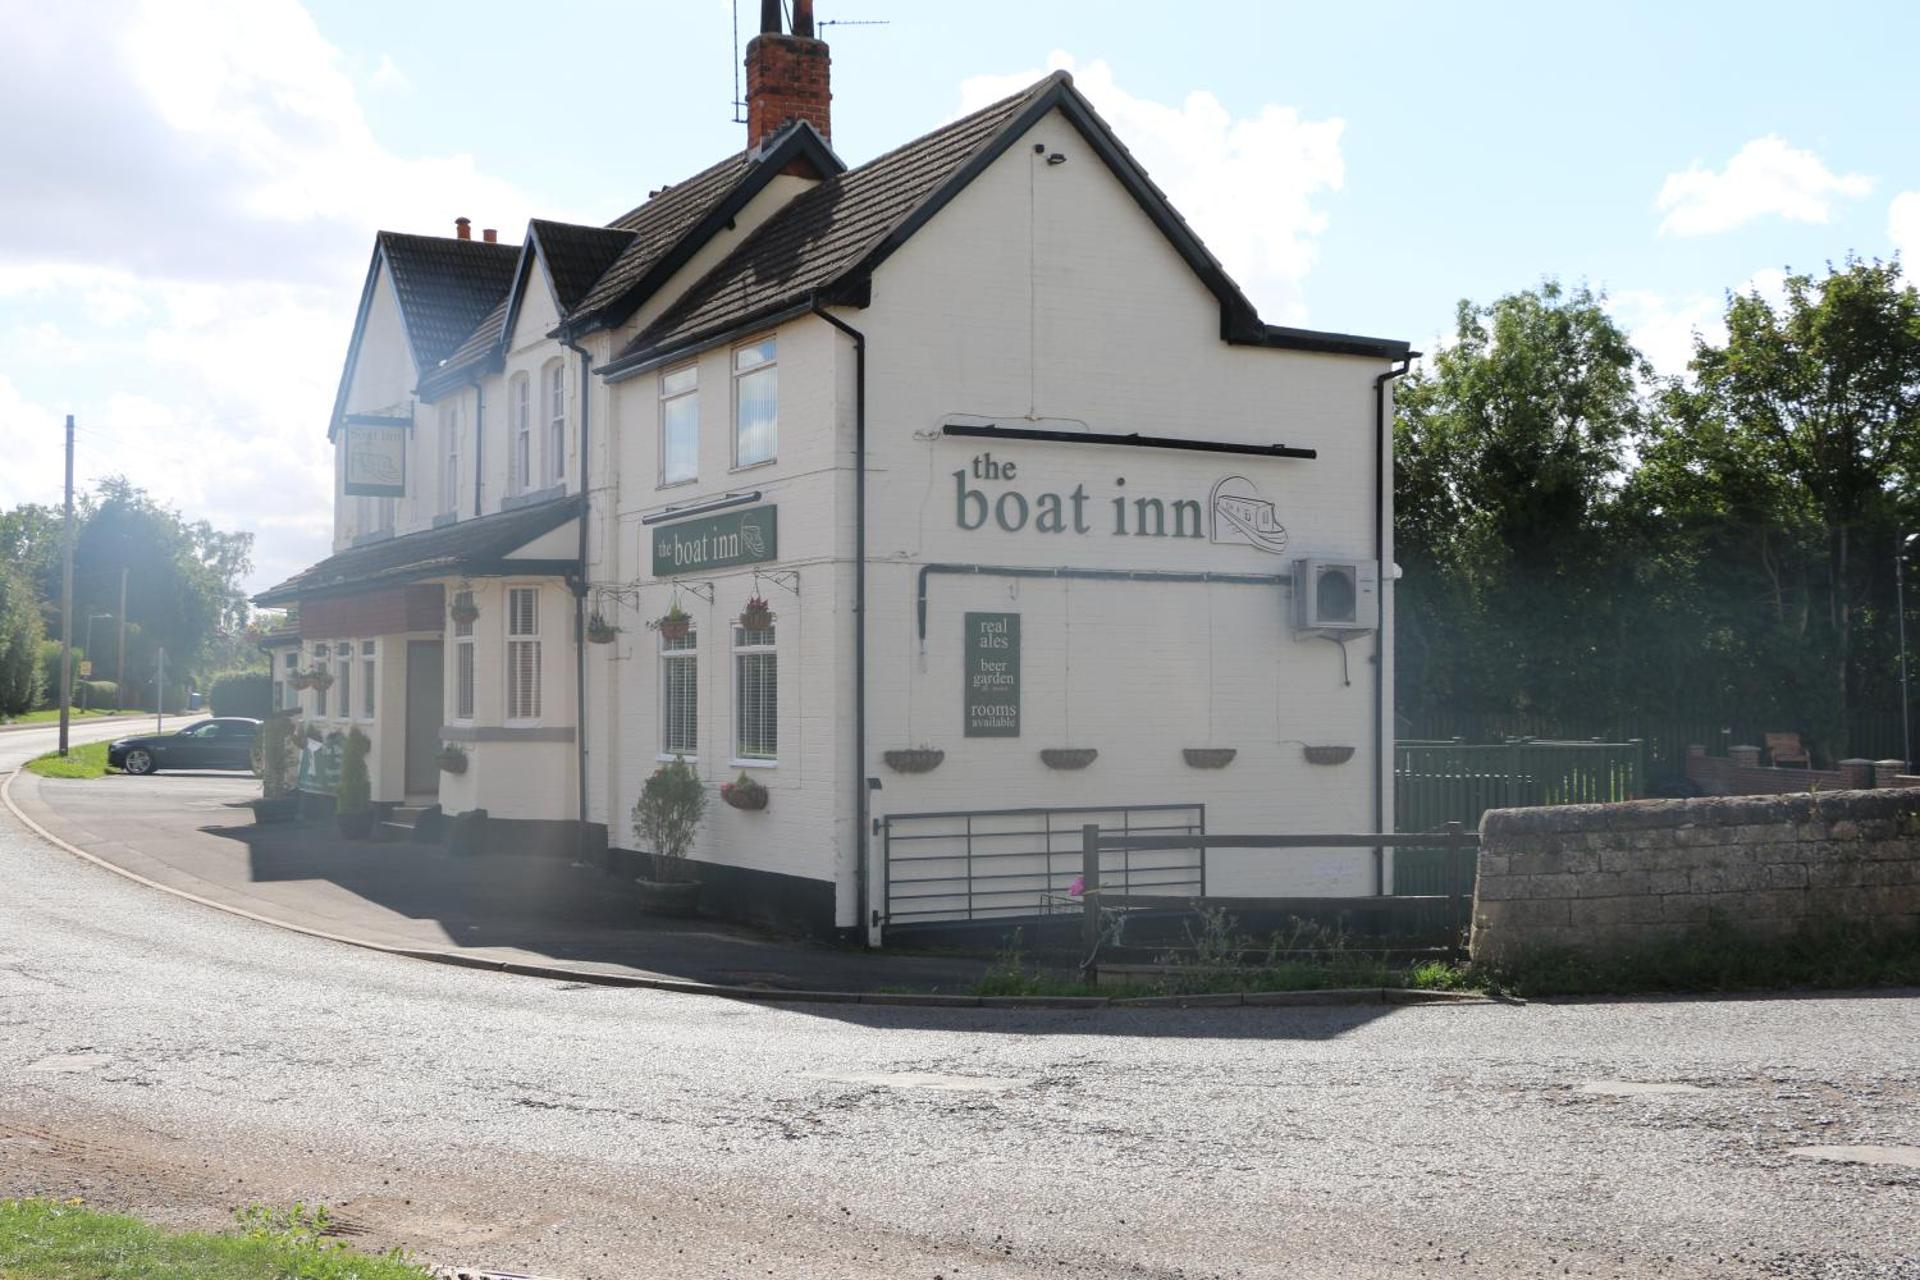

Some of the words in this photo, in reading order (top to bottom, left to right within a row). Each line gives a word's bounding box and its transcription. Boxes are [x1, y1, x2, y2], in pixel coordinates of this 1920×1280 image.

[972, 452, 1017, 480] the
[952, 469, 1091, 534] boat
[1111, 477, 1205, 539] inn
[658, 540, 672, 558] the
[674, 533, 708, 566] boat
[713, 525, 739, 560] inn
[980, 618, 1008, 633] real
[979, 632, 1009, 649] ales
[981, 658, 1008, 672] beer
[973, 672, 1014, 687] garden
[971, 704, 1017, 717] rooms
[972, 716, 1016, 728] available
